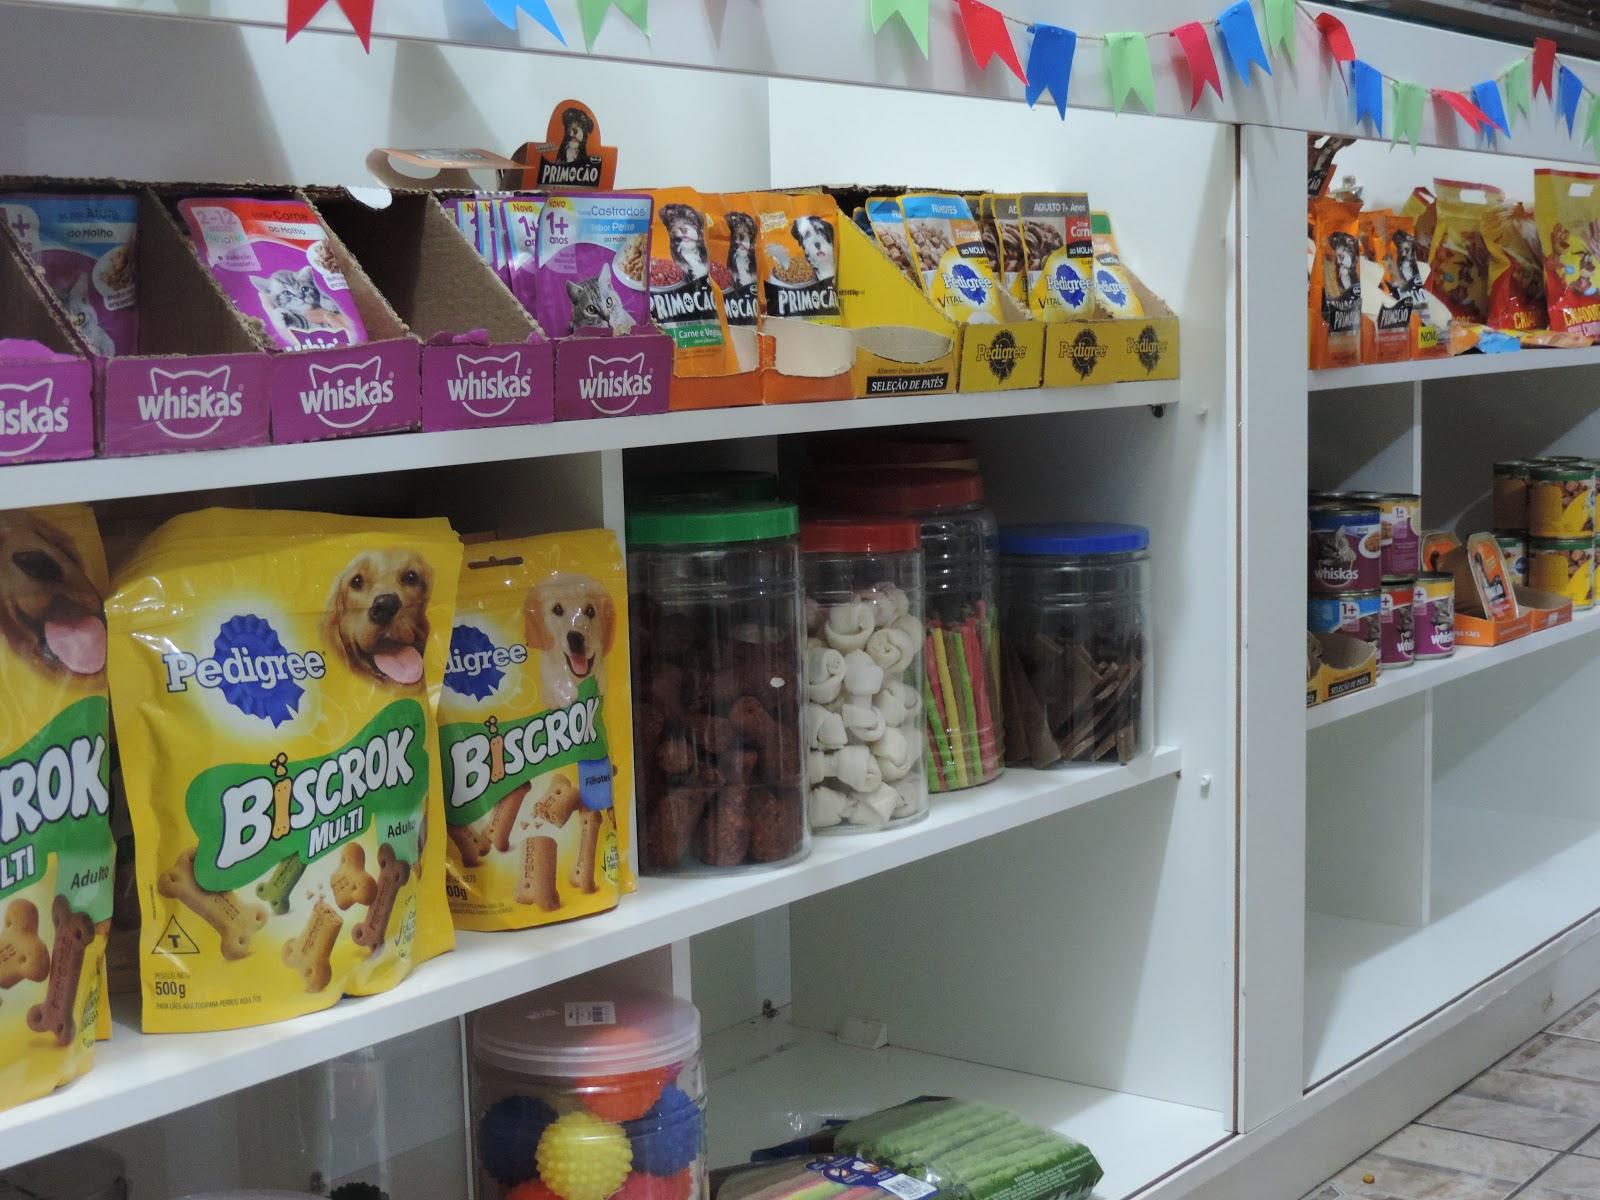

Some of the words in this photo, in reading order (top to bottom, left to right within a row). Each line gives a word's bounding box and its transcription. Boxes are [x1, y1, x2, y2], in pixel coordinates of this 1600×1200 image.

[542, 163, 599, 184] PRIMOCÃO
[591, 205, 646, 217] Castrados
[546, 211, 569, 235] 1+
[969, 246, 986, 255] MOLH
[1076, 246, 1093, 255] MOLH
[941, 271, 993, 291] Pedigree
[1046, 274, 1092, 293] Pedigree
[725, 294, 758, 319] MOCÃO
[678, 329, 699, 339] Carne
[976, 341, 1027, 362] Pedigree
[447, 368, 531, 401] whiskas
[579, 370, 652, 400] whiskas
[871, 378, 909, 392] SELEÇÃO
[909, 379, 921, 390] DE
[921, 376, 944, 389] PATÊS
[138, 382, 243, 421] whiskas
[300, 377, 394, 416] whiskas
[0, 400, 69, 436] iskas
[161, 646, 326, 693] Pedigree
[307, 805, 365, 859] MULTI
[70, 865, 110, 890] Adulto
[446, 885, 468, 900] 00g
